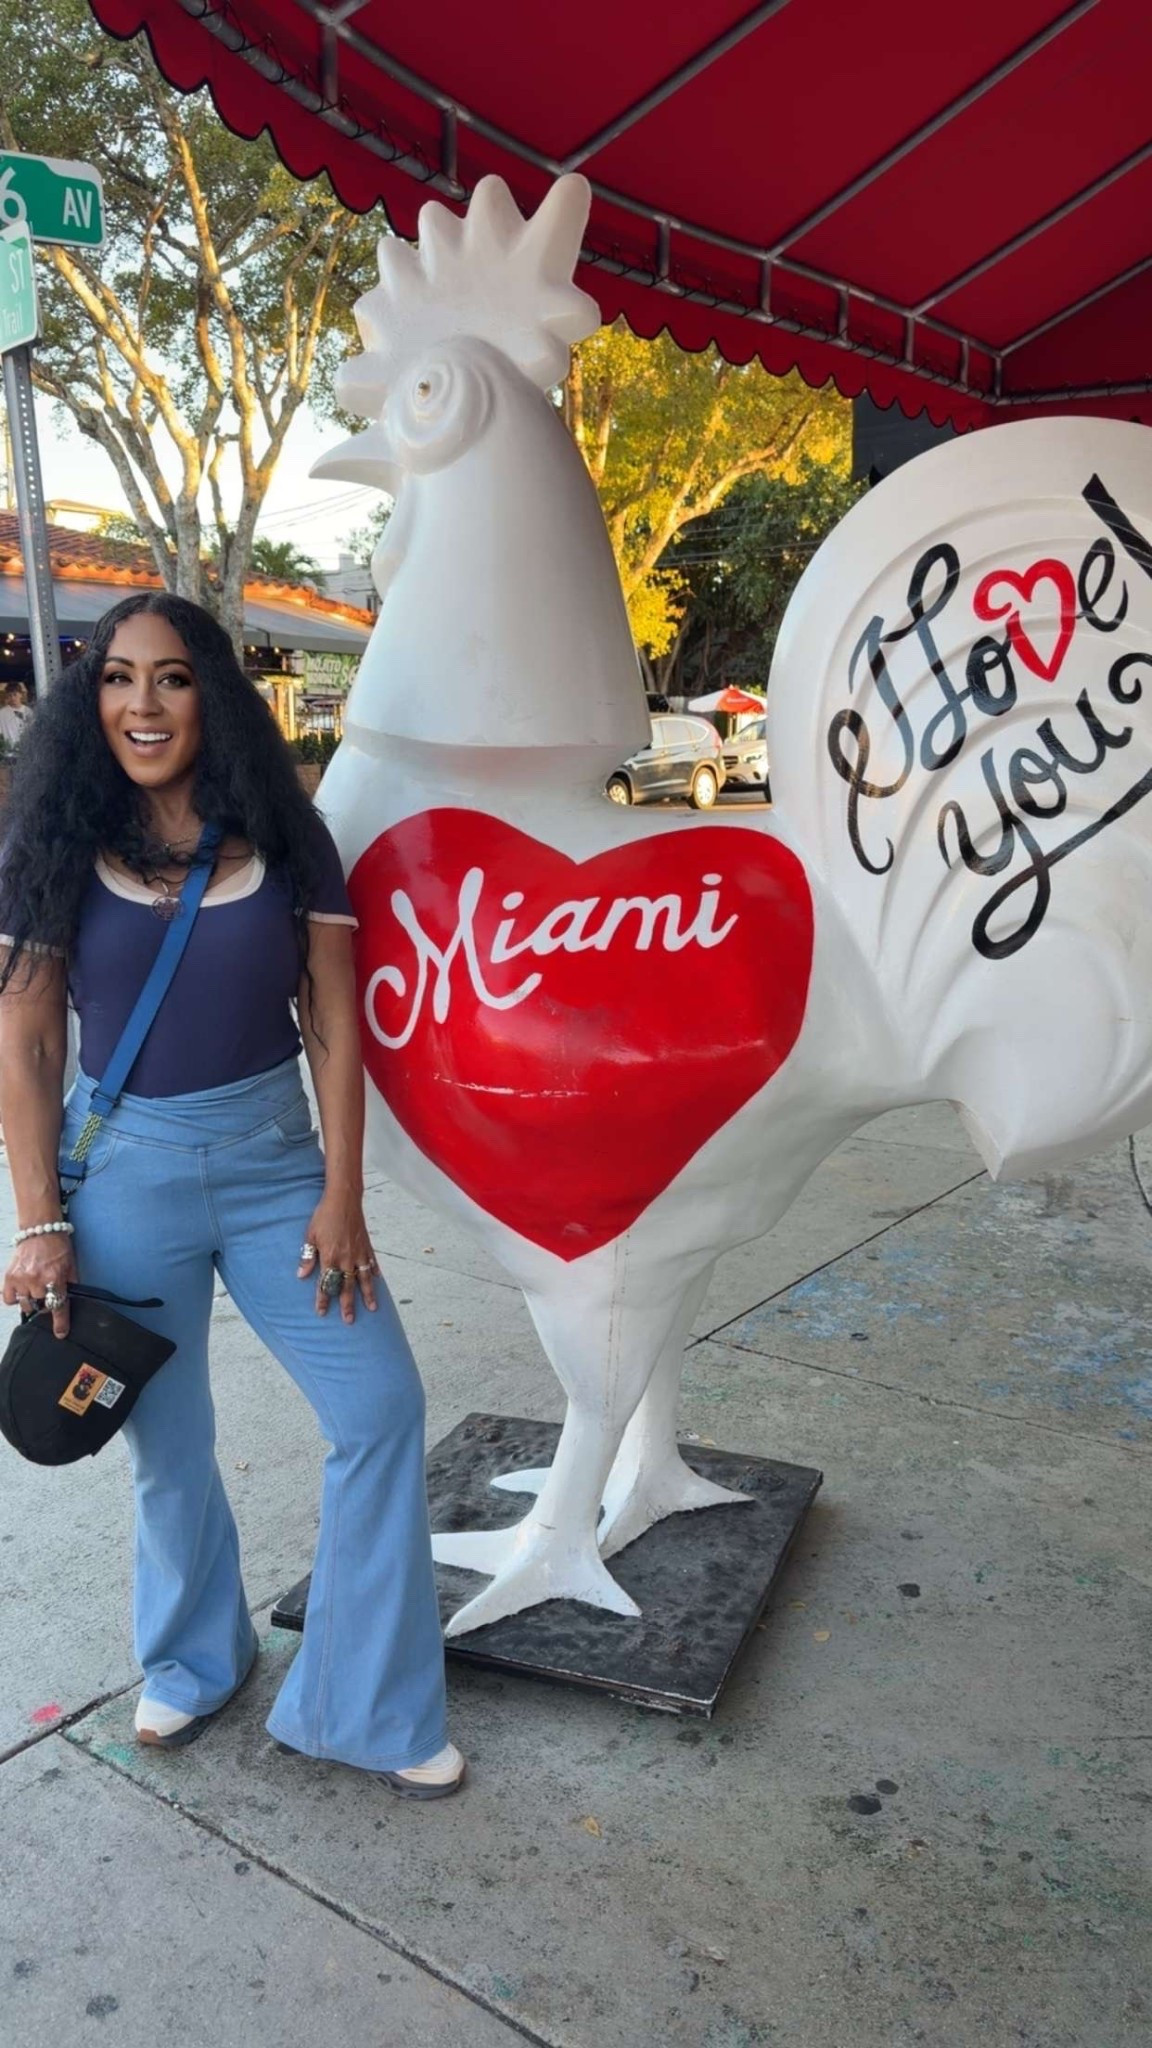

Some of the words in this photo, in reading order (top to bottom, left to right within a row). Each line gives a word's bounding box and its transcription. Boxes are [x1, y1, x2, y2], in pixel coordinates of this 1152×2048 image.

[62, 186, 93, 229] AV
[9, 248, 25, 293] ST
[365, 867, 740, 1049] Miami
